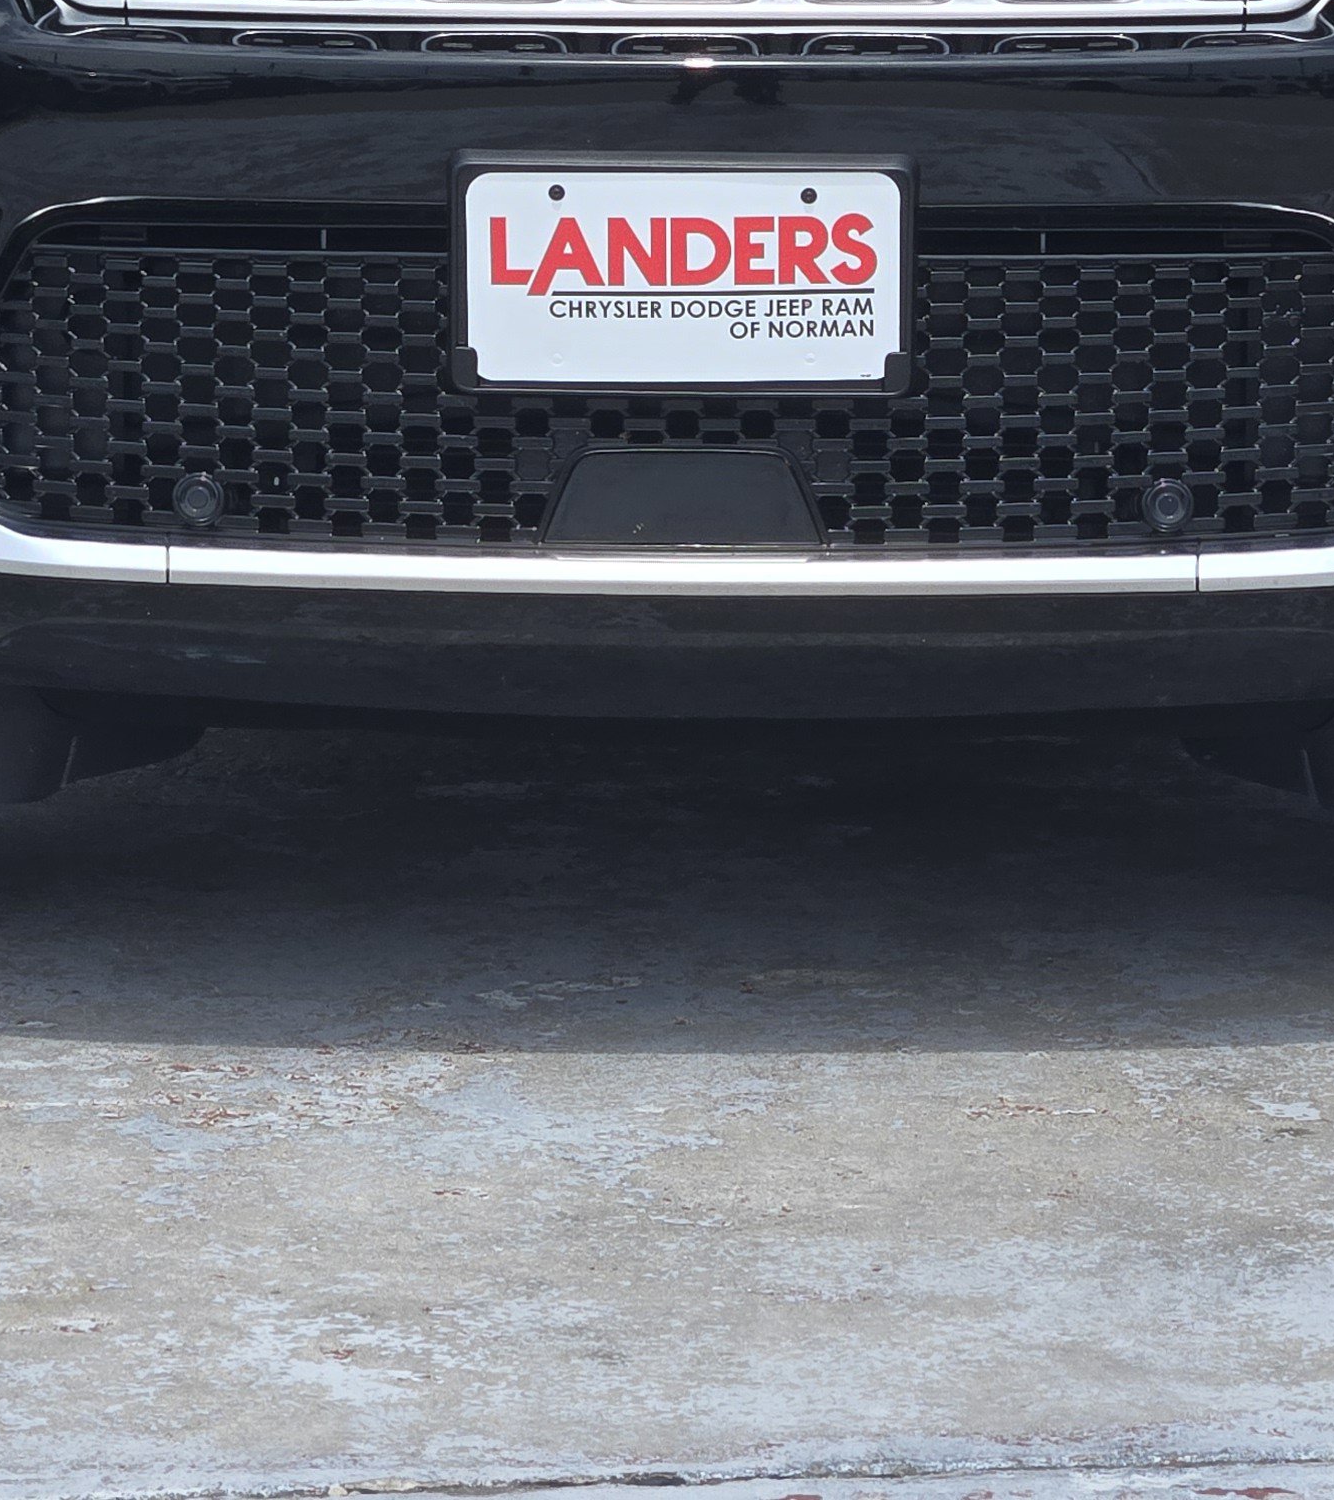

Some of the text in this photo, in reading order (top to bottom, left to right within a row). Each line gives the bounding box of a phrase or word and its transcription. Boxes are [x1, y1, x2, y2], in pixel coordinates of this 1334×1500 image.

[489, 213, 878, 296] LANDERS
[549, 297, 874, 319] CHRYSLER DODGE JEEP RAM
[730, 319, 874, 339] OF NORMAN
